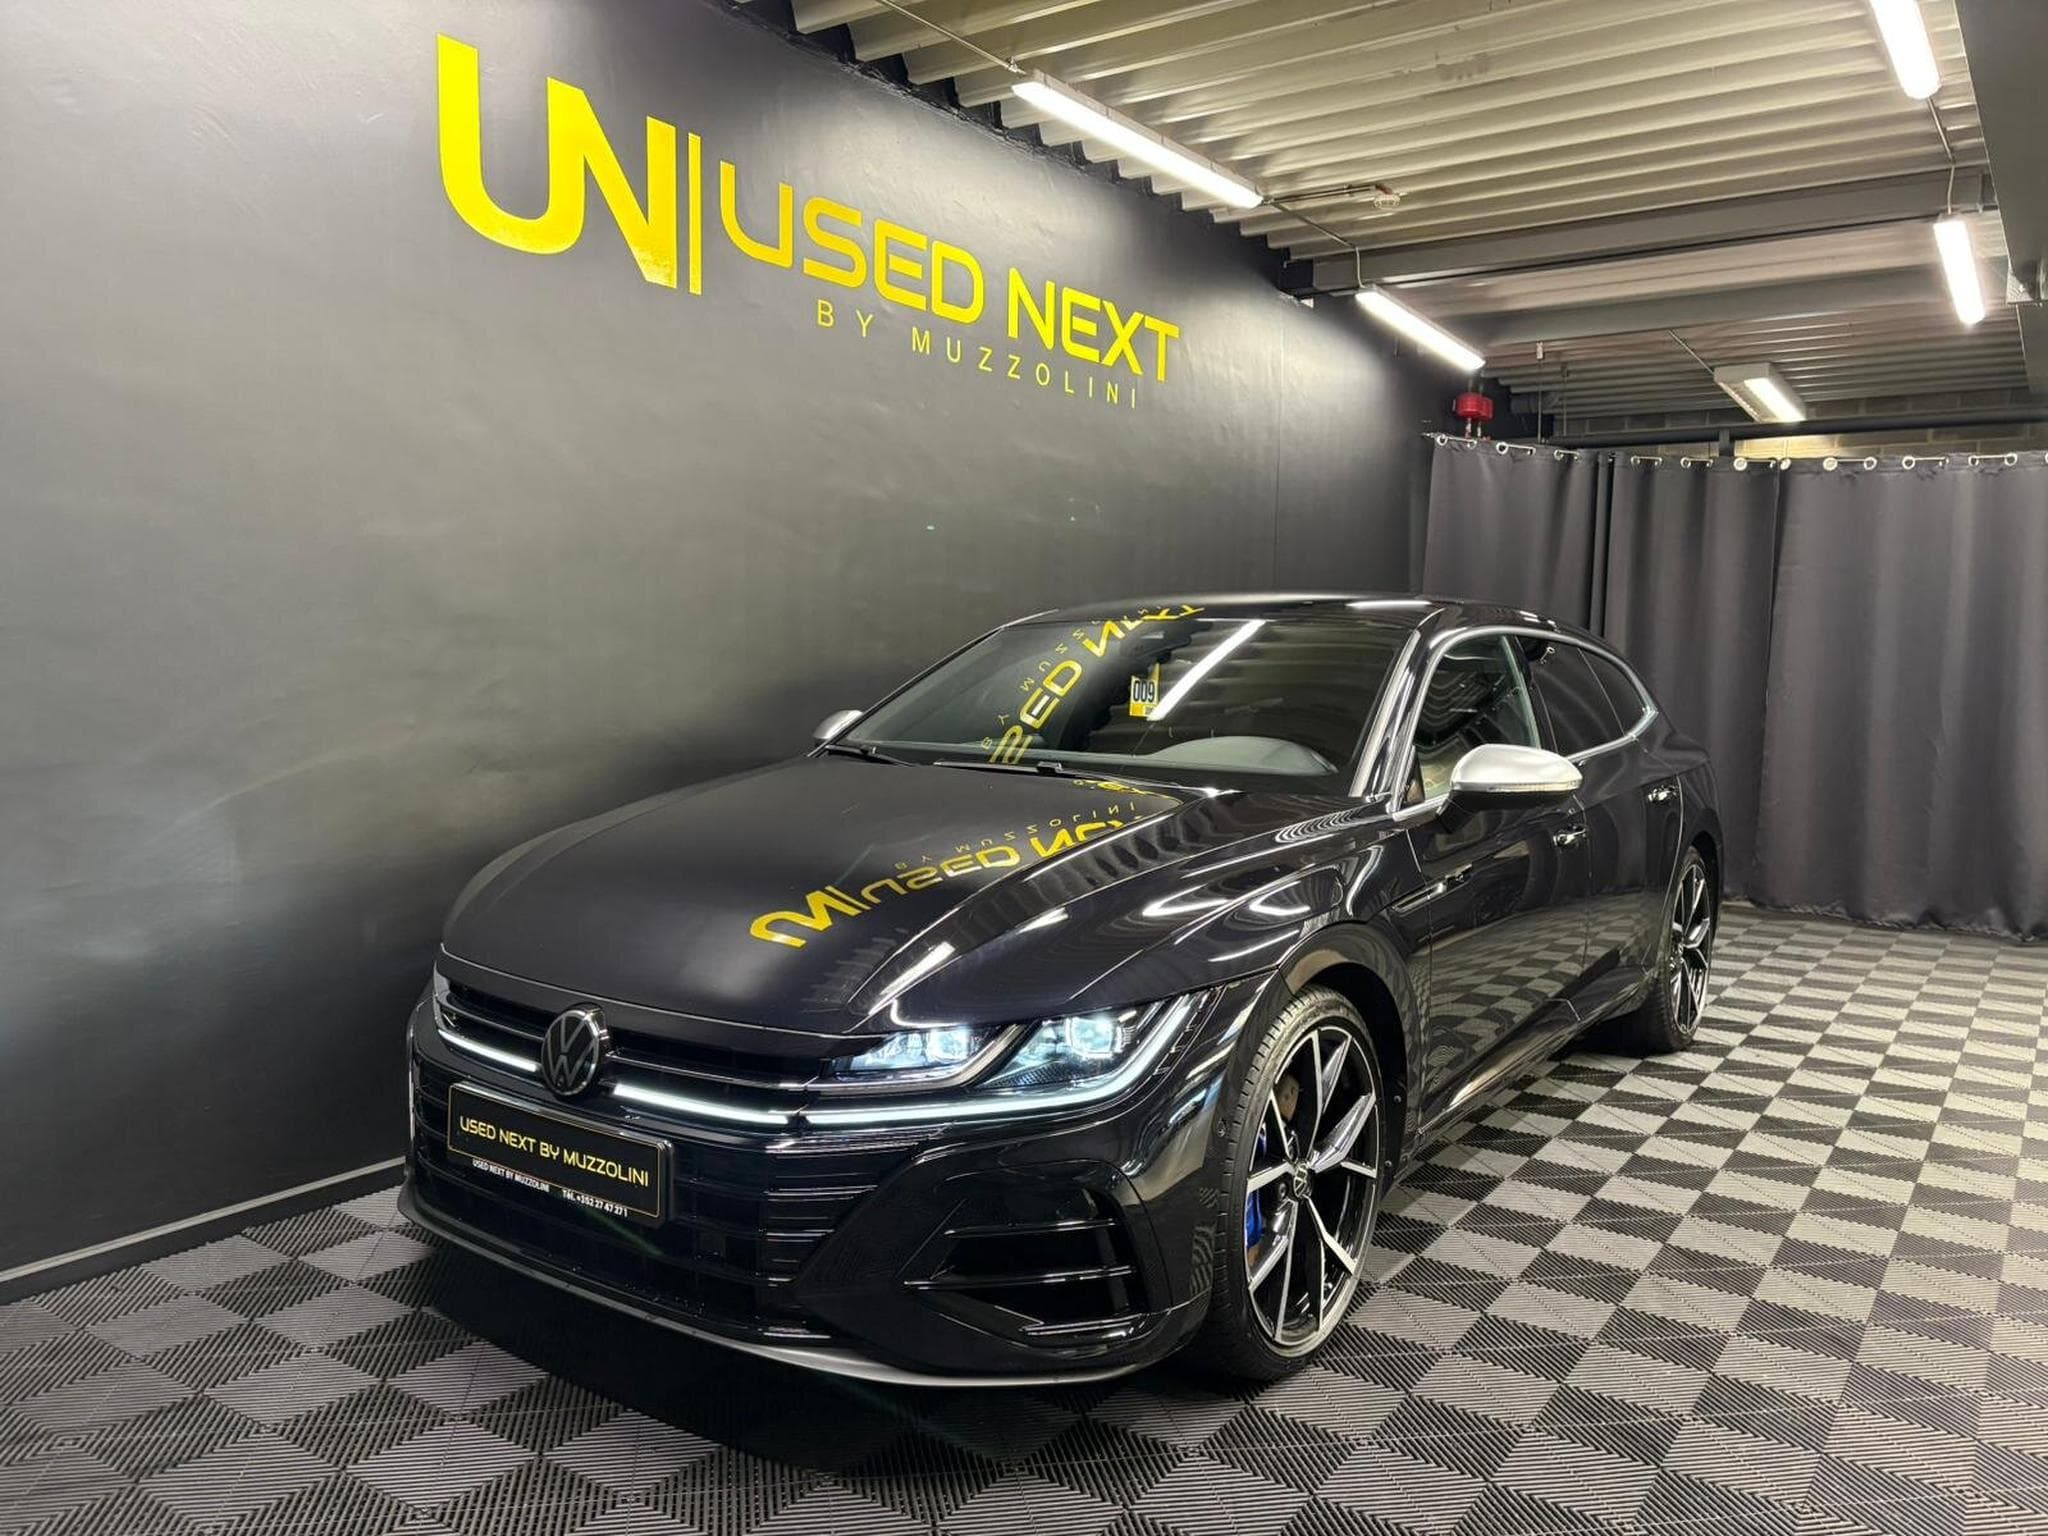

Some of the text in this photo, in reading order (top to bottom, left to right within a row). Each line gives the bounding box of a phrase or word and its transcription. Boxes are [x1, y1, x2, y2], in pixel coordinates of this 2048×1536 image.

[718, 160, 1181, 384] USED NEXT
[816, 299, 1138, 409] BY MUZZOLINI
[1133, 680, 1156, 703] 009
[459, 1115, 649, 1188] USED NEXT BY MUZZOLINI
